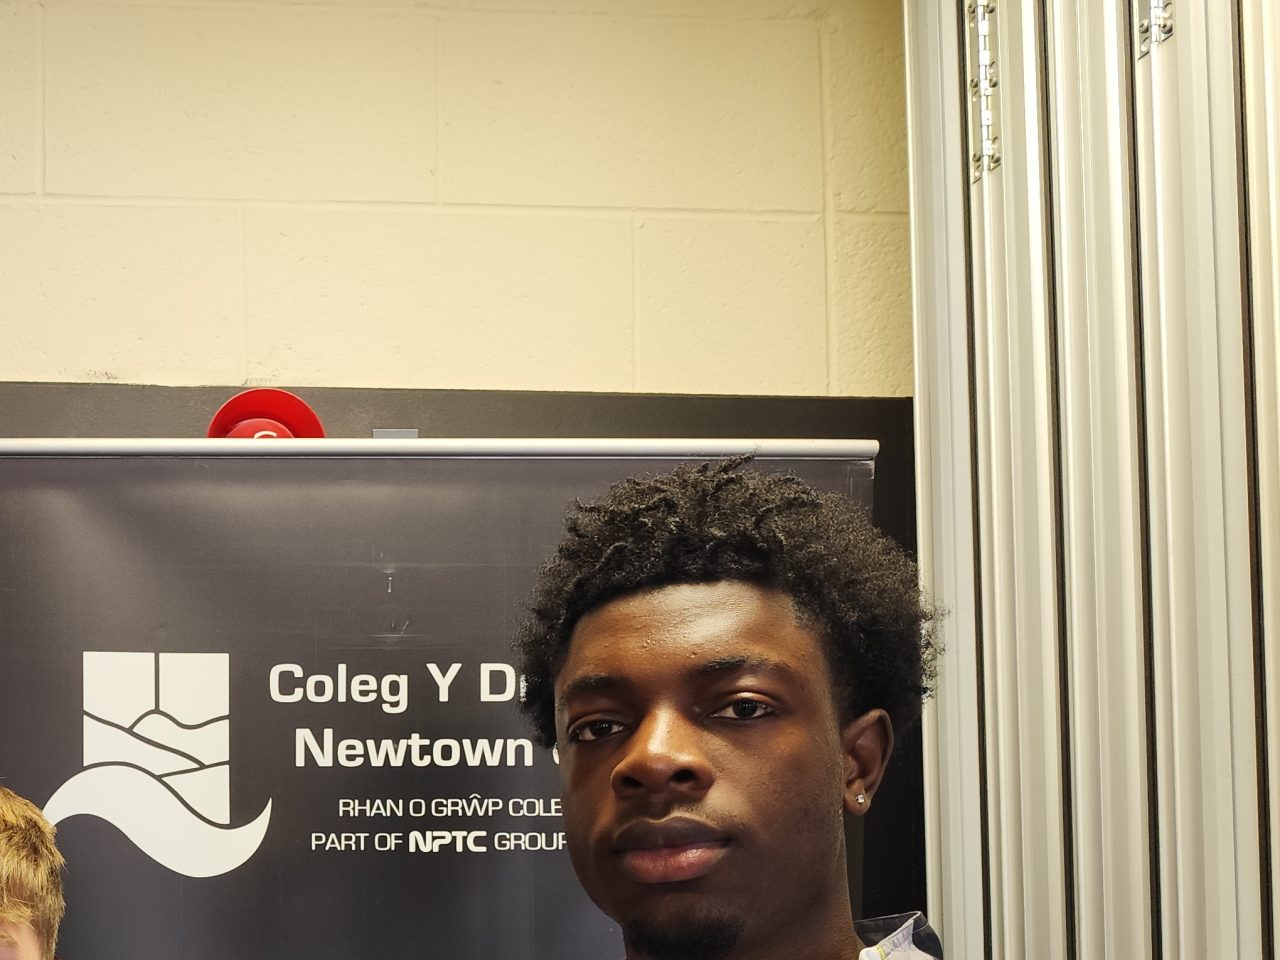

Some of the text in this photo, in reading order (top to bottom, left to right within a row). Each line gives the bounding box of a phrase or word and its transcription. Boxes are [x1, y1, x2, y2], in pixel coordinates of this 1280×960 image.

[269, 662, 409, 714] Coleg
[425, 662, 463, 703] Y
[295, 727, 534, 768] Newtown
[338, 798, 403, 817] RHAN
[409, 798, 426, 817] O
[508, 798, 563, 817] COLE
[311, 832, 370, 851] PART
[374, 832, 404, 851] OF
[408, 830, 487, 853] NPTC
